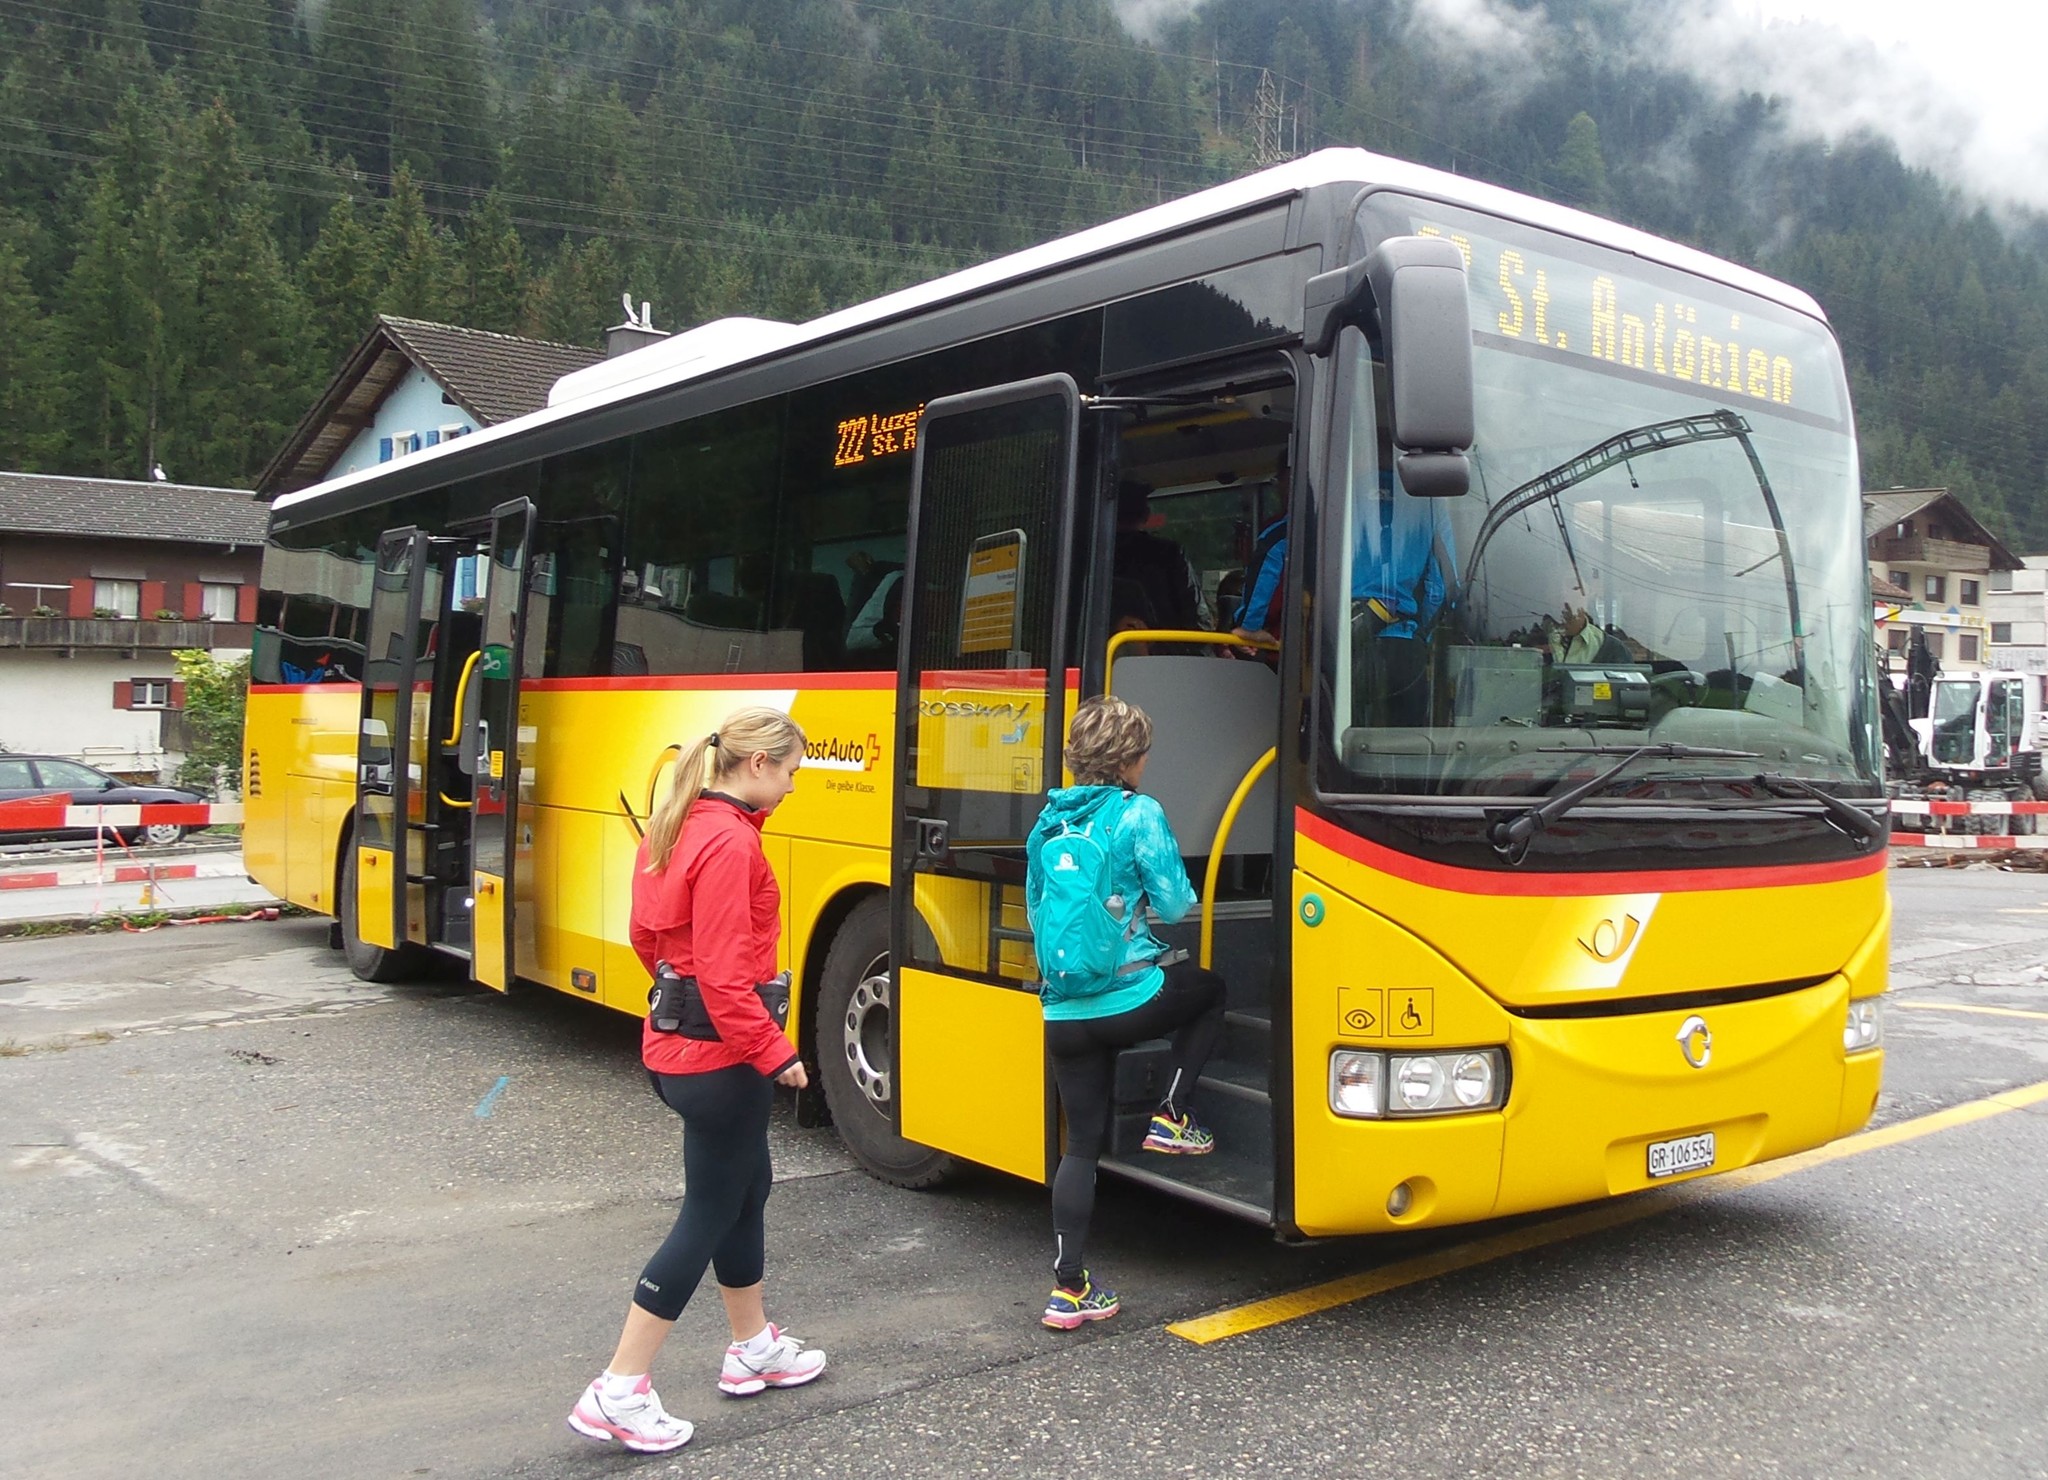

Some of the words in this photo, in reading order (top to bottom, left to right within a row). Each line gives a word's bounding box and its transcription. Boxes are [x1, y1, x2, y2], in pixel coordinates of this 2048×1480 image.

[1498, 249, 1569, 350] St.
[1591, 275, 1795, 405] Antönien
[834, 416, 868, 466] 222
[805, 737, 864, 763] ostAuto
[826, 779, 836, 790] Die
[837, 780, 854, 793] gelbe
